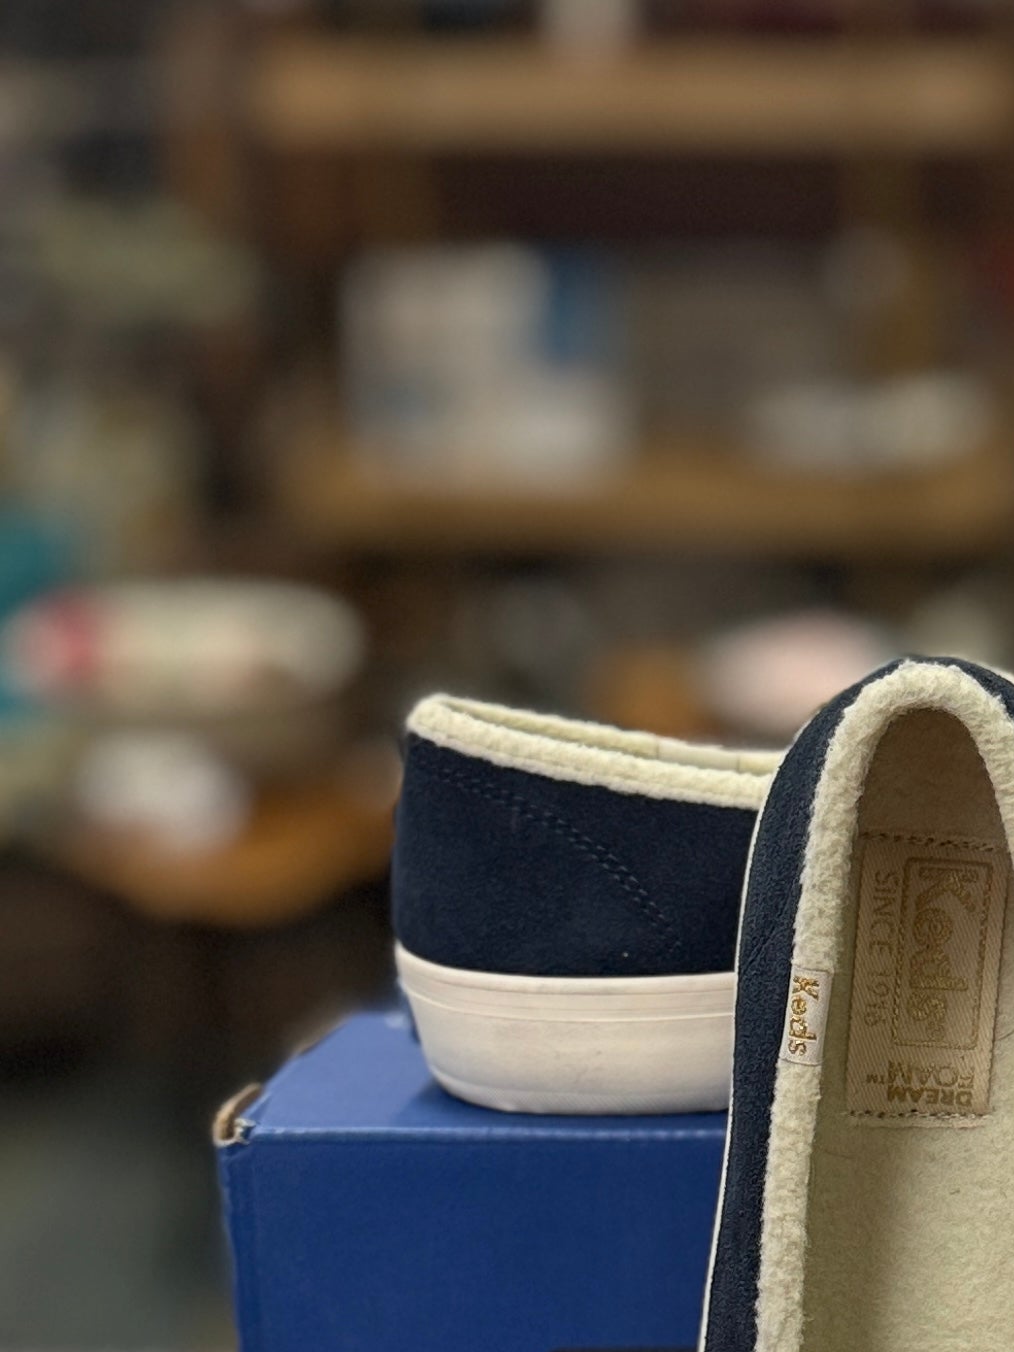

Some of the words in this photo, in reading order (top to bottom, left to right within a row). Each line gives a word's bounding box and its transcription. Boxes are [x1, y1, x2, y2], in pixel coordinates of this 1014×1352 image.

[871, 870, 895, 960] SINCE
[787, 975, 820, 1056] Keds
[887, 1086, 973, 1107] DREAM
